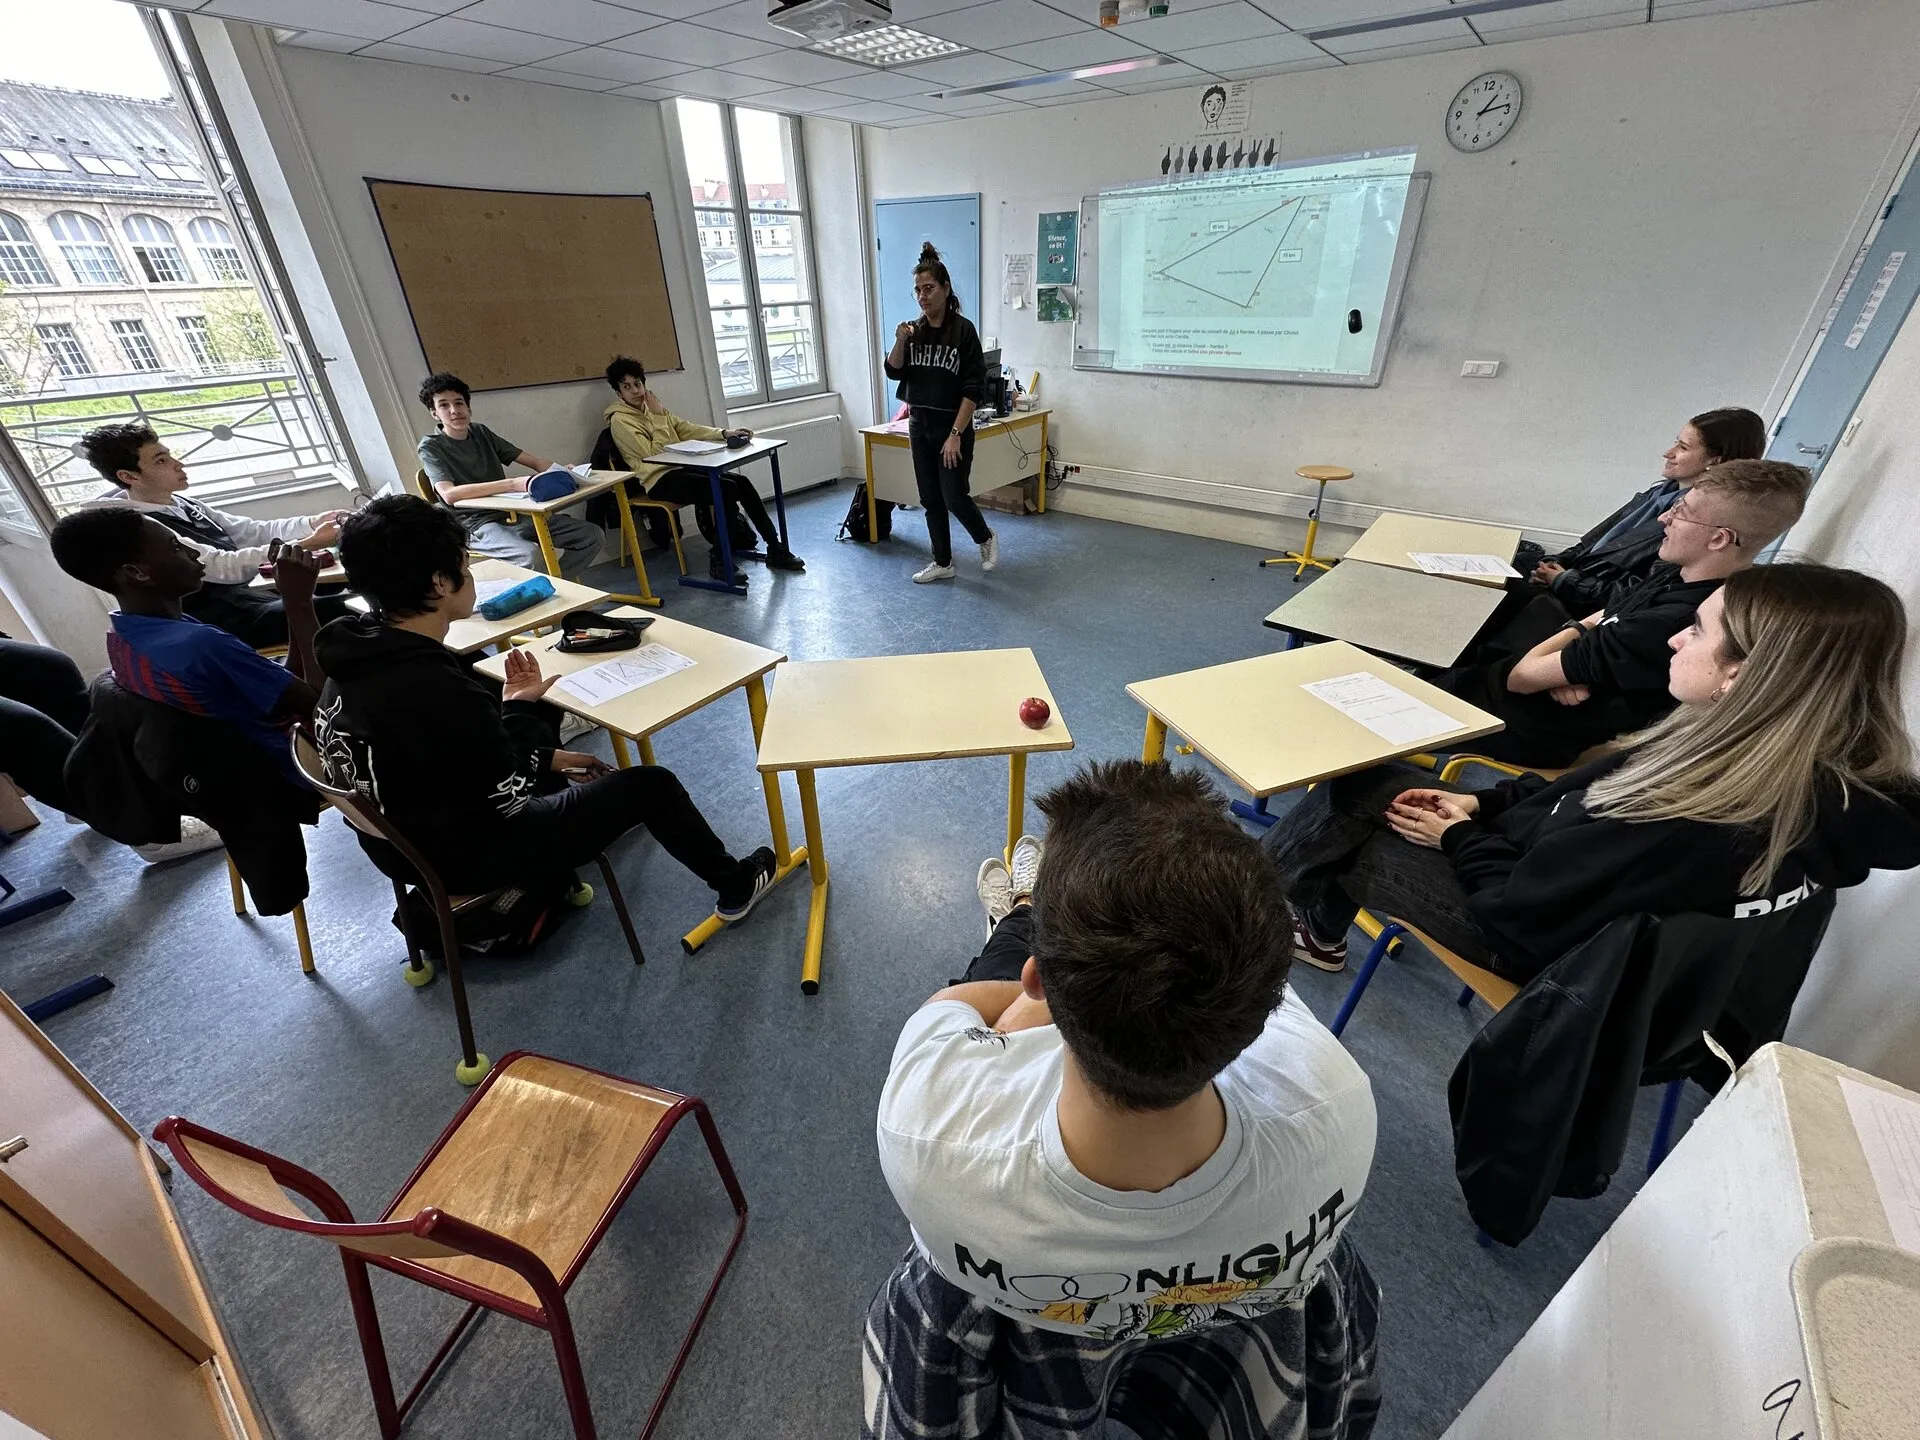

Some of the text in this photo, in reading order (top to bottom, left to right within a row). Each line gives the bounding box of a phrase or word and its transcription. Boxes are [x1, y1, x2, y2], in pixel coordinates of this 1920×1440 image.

[1483, 80, 1496, 91] 12
[1503, 104, 1510, 115] 3
[1455, 110, 1462, 120] 9
[1472, 134, 1479, 143] 6
[1047, 234, 1068, 242] Silence,
[953, 1188, 1346, 1302] MOONLIGHT
